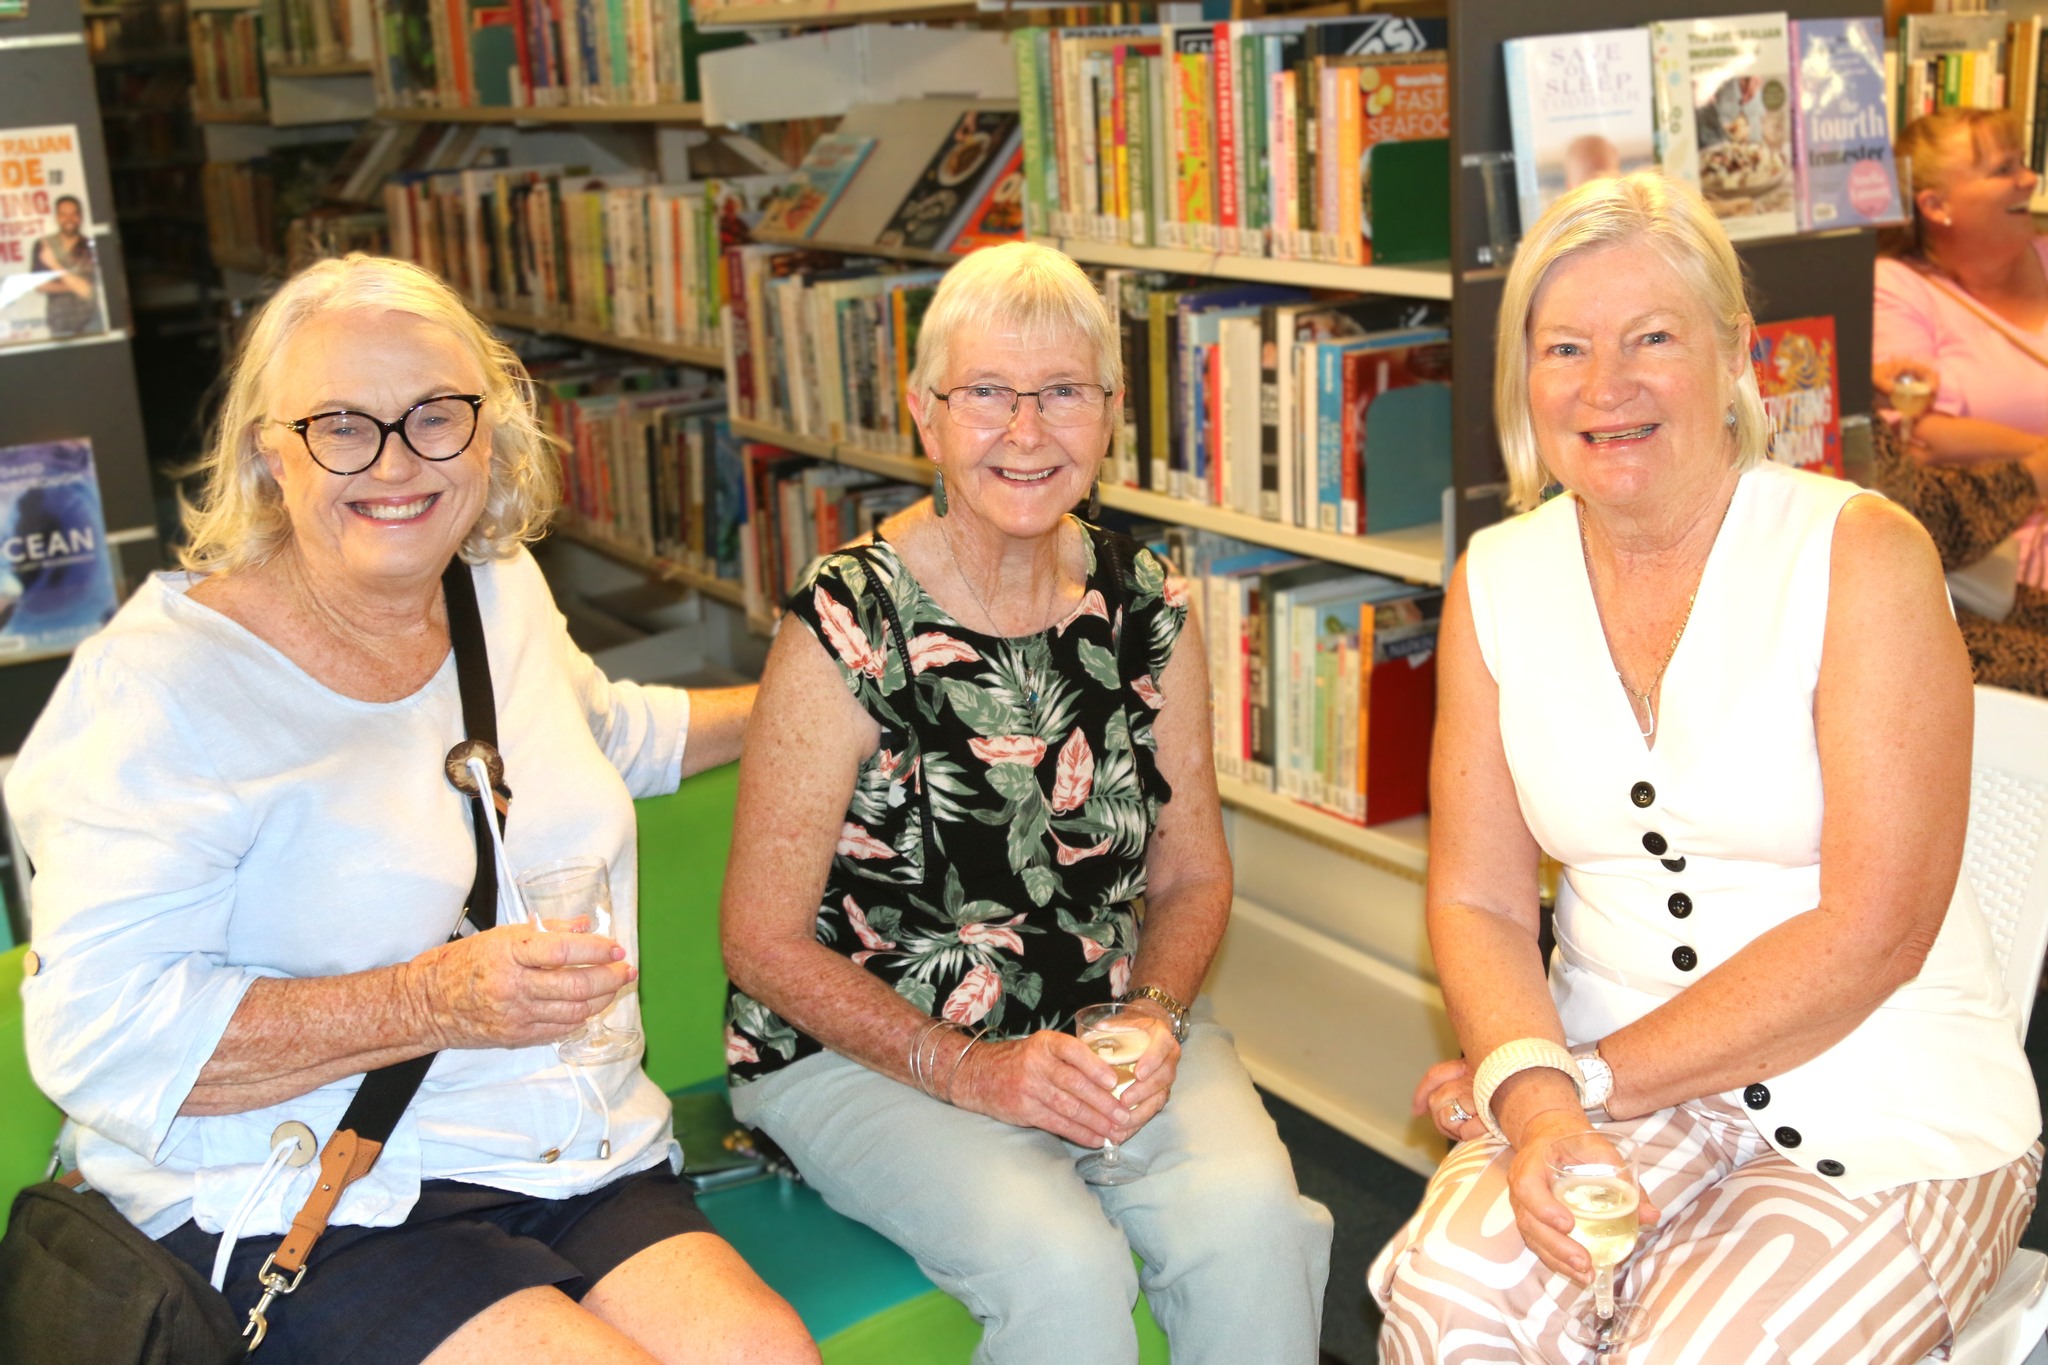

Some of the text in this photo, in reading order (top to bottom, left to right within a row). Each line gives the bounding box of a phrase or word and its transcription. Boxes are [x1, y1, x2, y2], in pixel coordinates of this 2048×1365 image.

[1551, 43, 1621, 66] SAVE
[1396, 88, 1445, 112] FAST
[1546, 72, 1632, 98] SLEEP
[1188, 109, 1200, 158] CURRY
[1218, 39, 1235, 217] OTTOLENGHI FLAVOUR
[1811, 103, 1885, 143] fourth
[0, 134, 72, 156] RALIAN
[2, 526, 96, 564] CEAN
